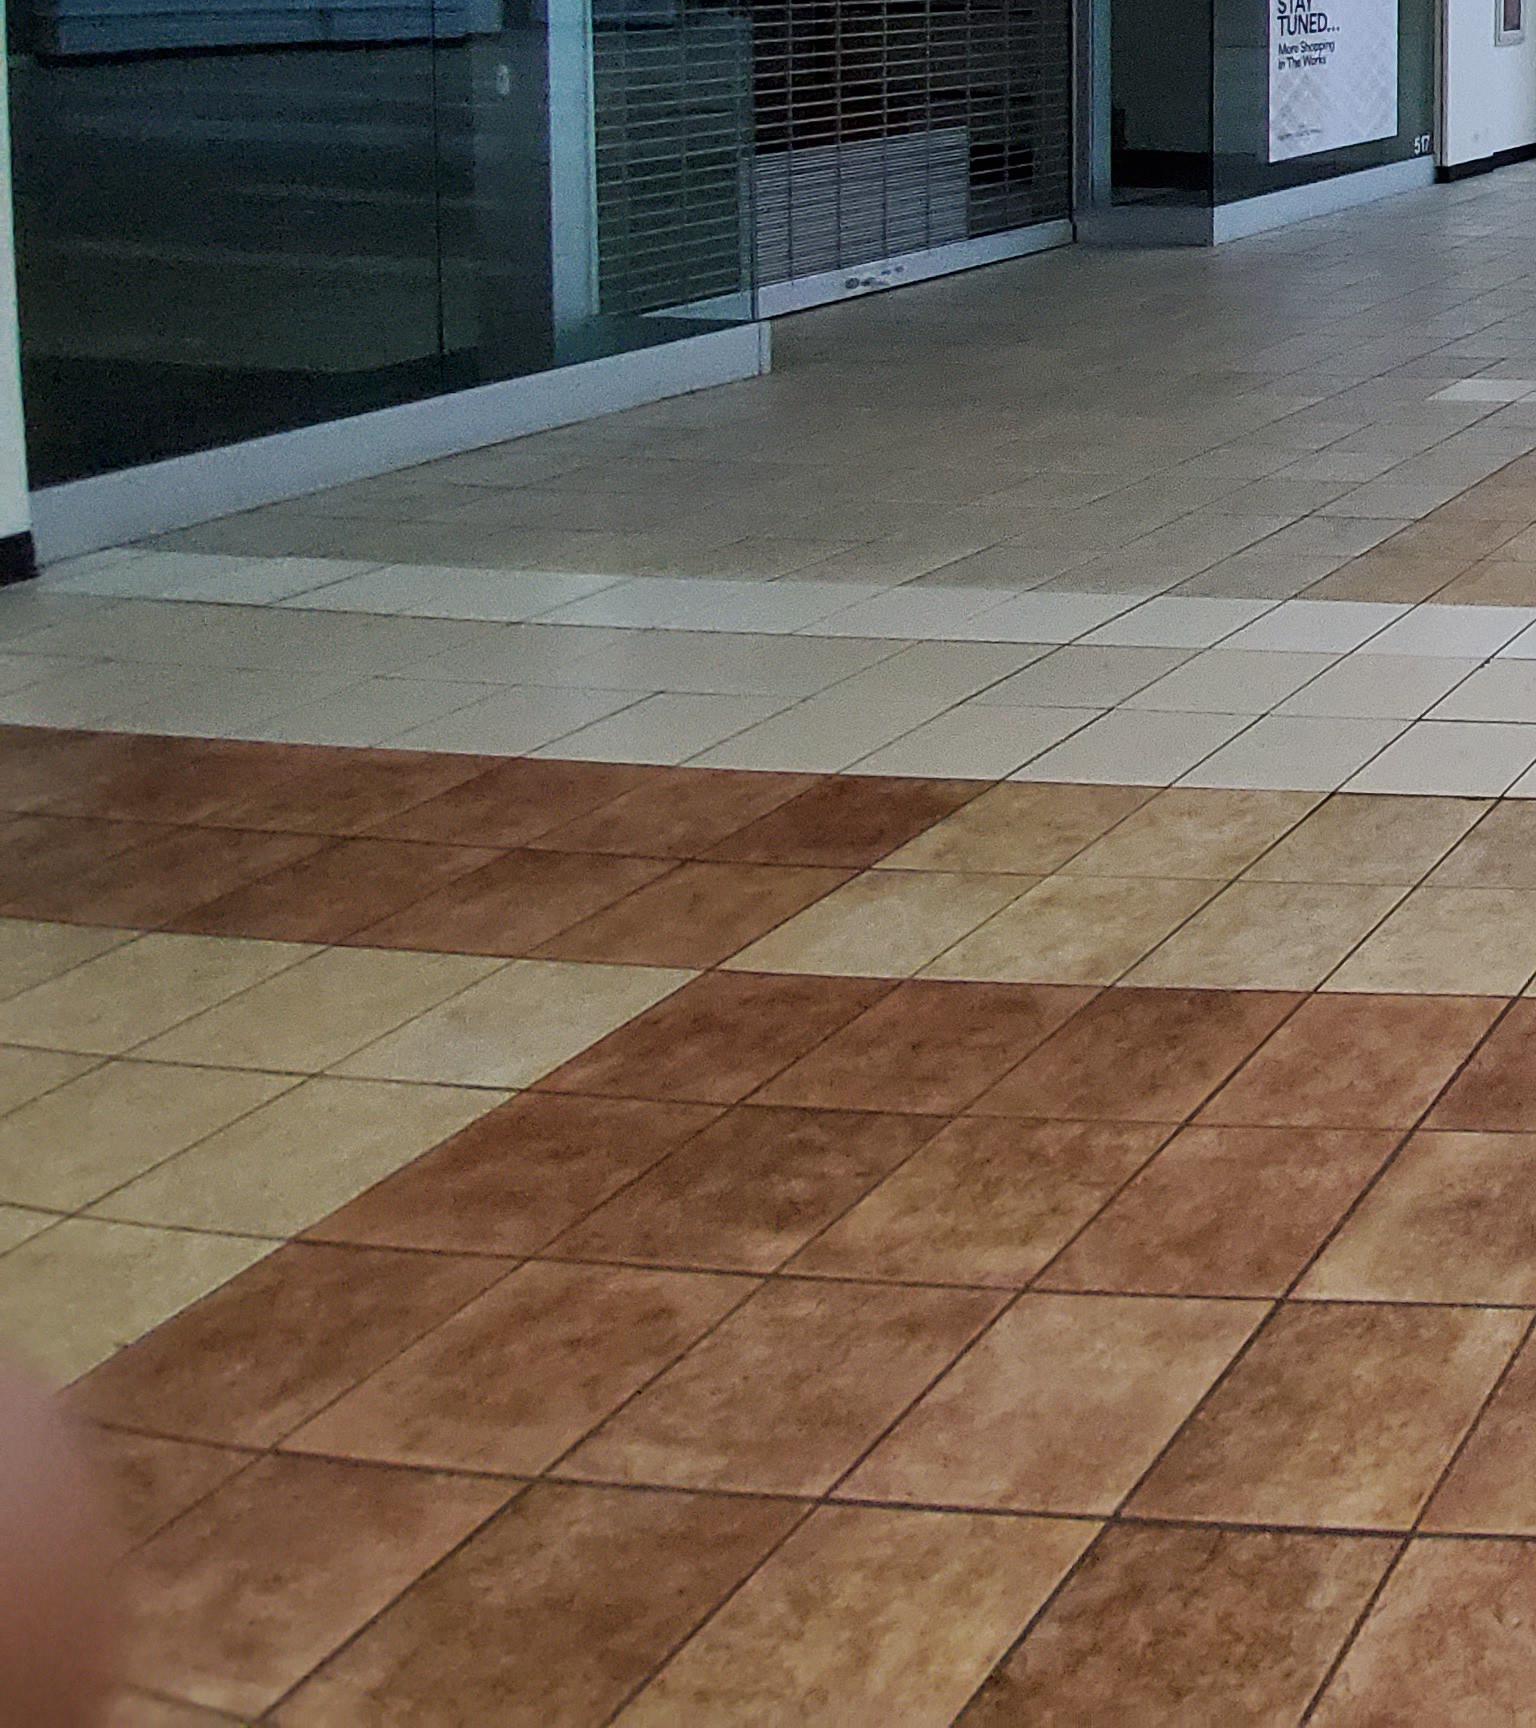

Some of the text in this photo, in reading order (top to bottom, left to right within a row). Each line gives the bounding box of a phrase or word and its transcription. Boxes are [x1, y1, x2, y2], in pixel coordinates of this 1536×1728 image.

[1278, 40, 1335, 56] More Shopping
[1278, 55, 1326, 70] In The Works
